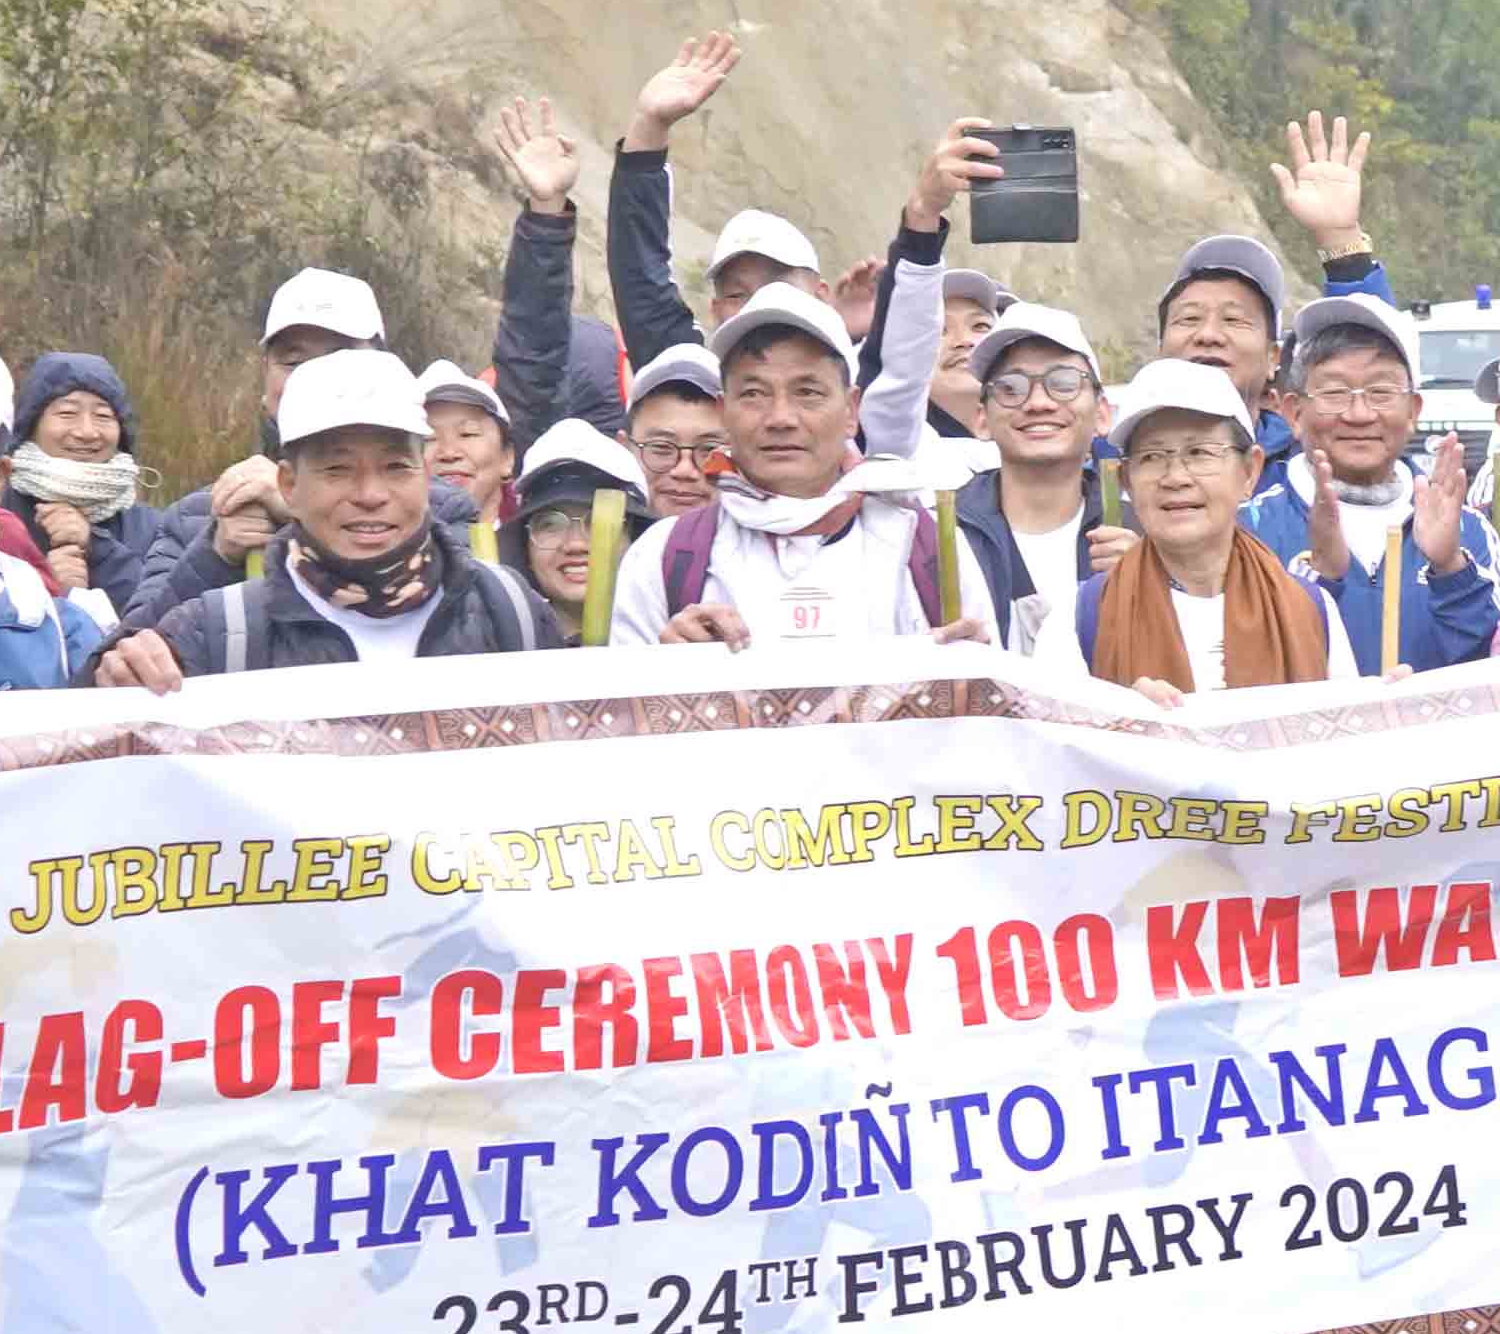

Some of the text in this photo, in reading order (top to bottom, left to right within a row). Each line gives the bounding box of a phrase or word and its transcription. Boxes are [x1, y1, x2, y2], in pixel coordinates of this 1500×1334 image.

[793, 605, 821, 629] 97
[10, 833, 392, 934] JUBILLEE
[411, 816, 701, 897] CAPITAL
[710, 793, 1045, 873] COMPLEX
[1060, 790, 1269, 850] DREE
[429, 932, 915, 1081] CEREMONY
[936, 912, 1119, 1028] 100
[1145, 894, 1301, 1002] KM
[174, 1140, 556, 1297] (KHAT
[586, 1080, 915, 1229] KODIÑ
[931, 1083, 1066, 1184] TO
[837, 1193, 1255, 1324] FEBRUARY
[1279, 1164, 1468, 1252] 2024
